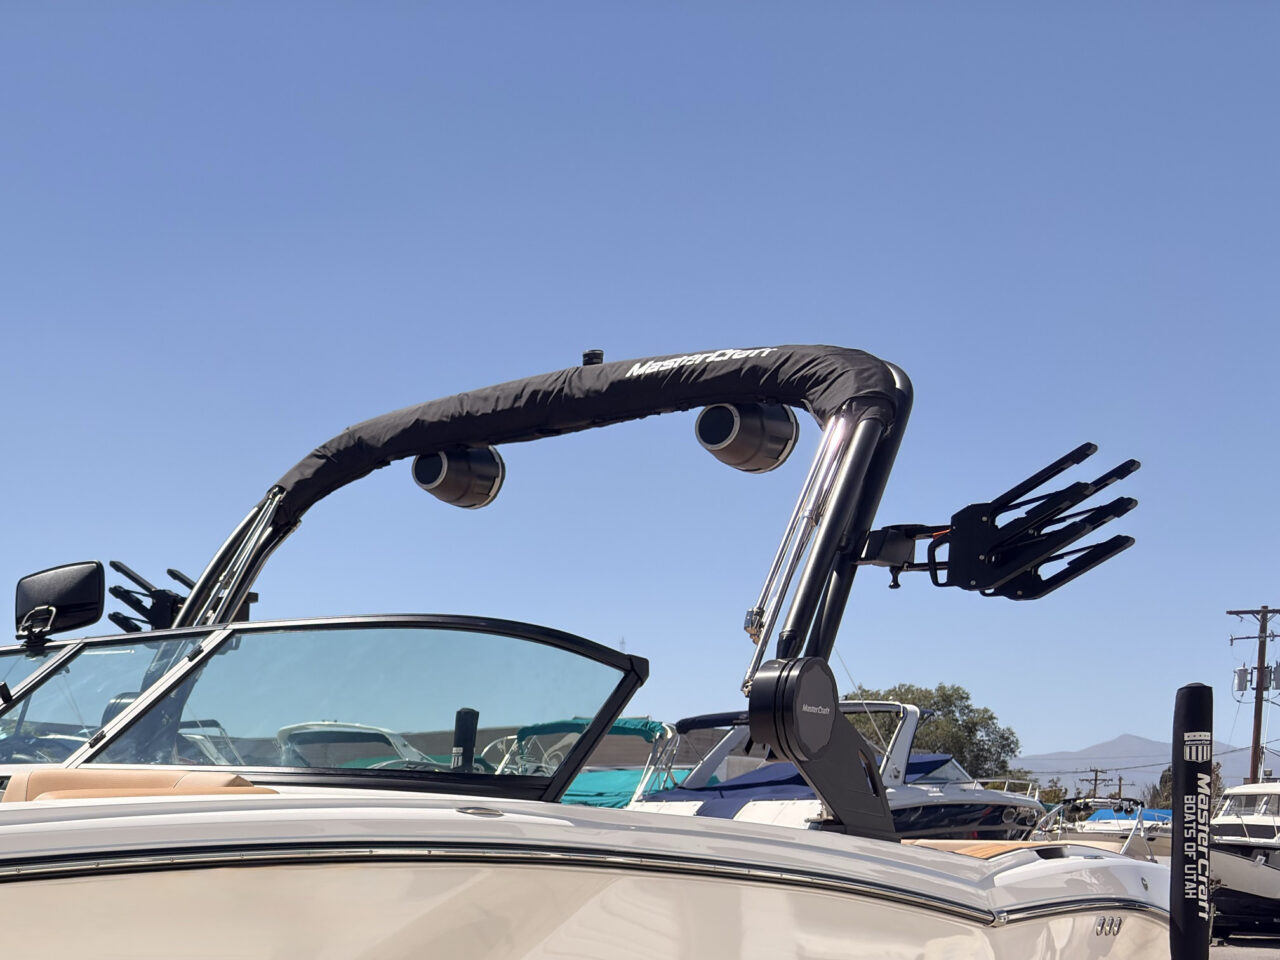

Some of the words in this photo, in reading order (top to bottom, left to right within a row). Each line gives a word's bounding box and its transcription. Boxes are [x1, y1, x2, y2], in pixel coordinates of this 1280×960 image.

[625, 347, 778, 378] MasterCraft
[1184, 795, 1196, 838] BOATS
[1184, 843, 1196, 861] OF
[1196, 772, 1211, 922] MasterCraft
[1185, 864, 1197, 899] UTAH
